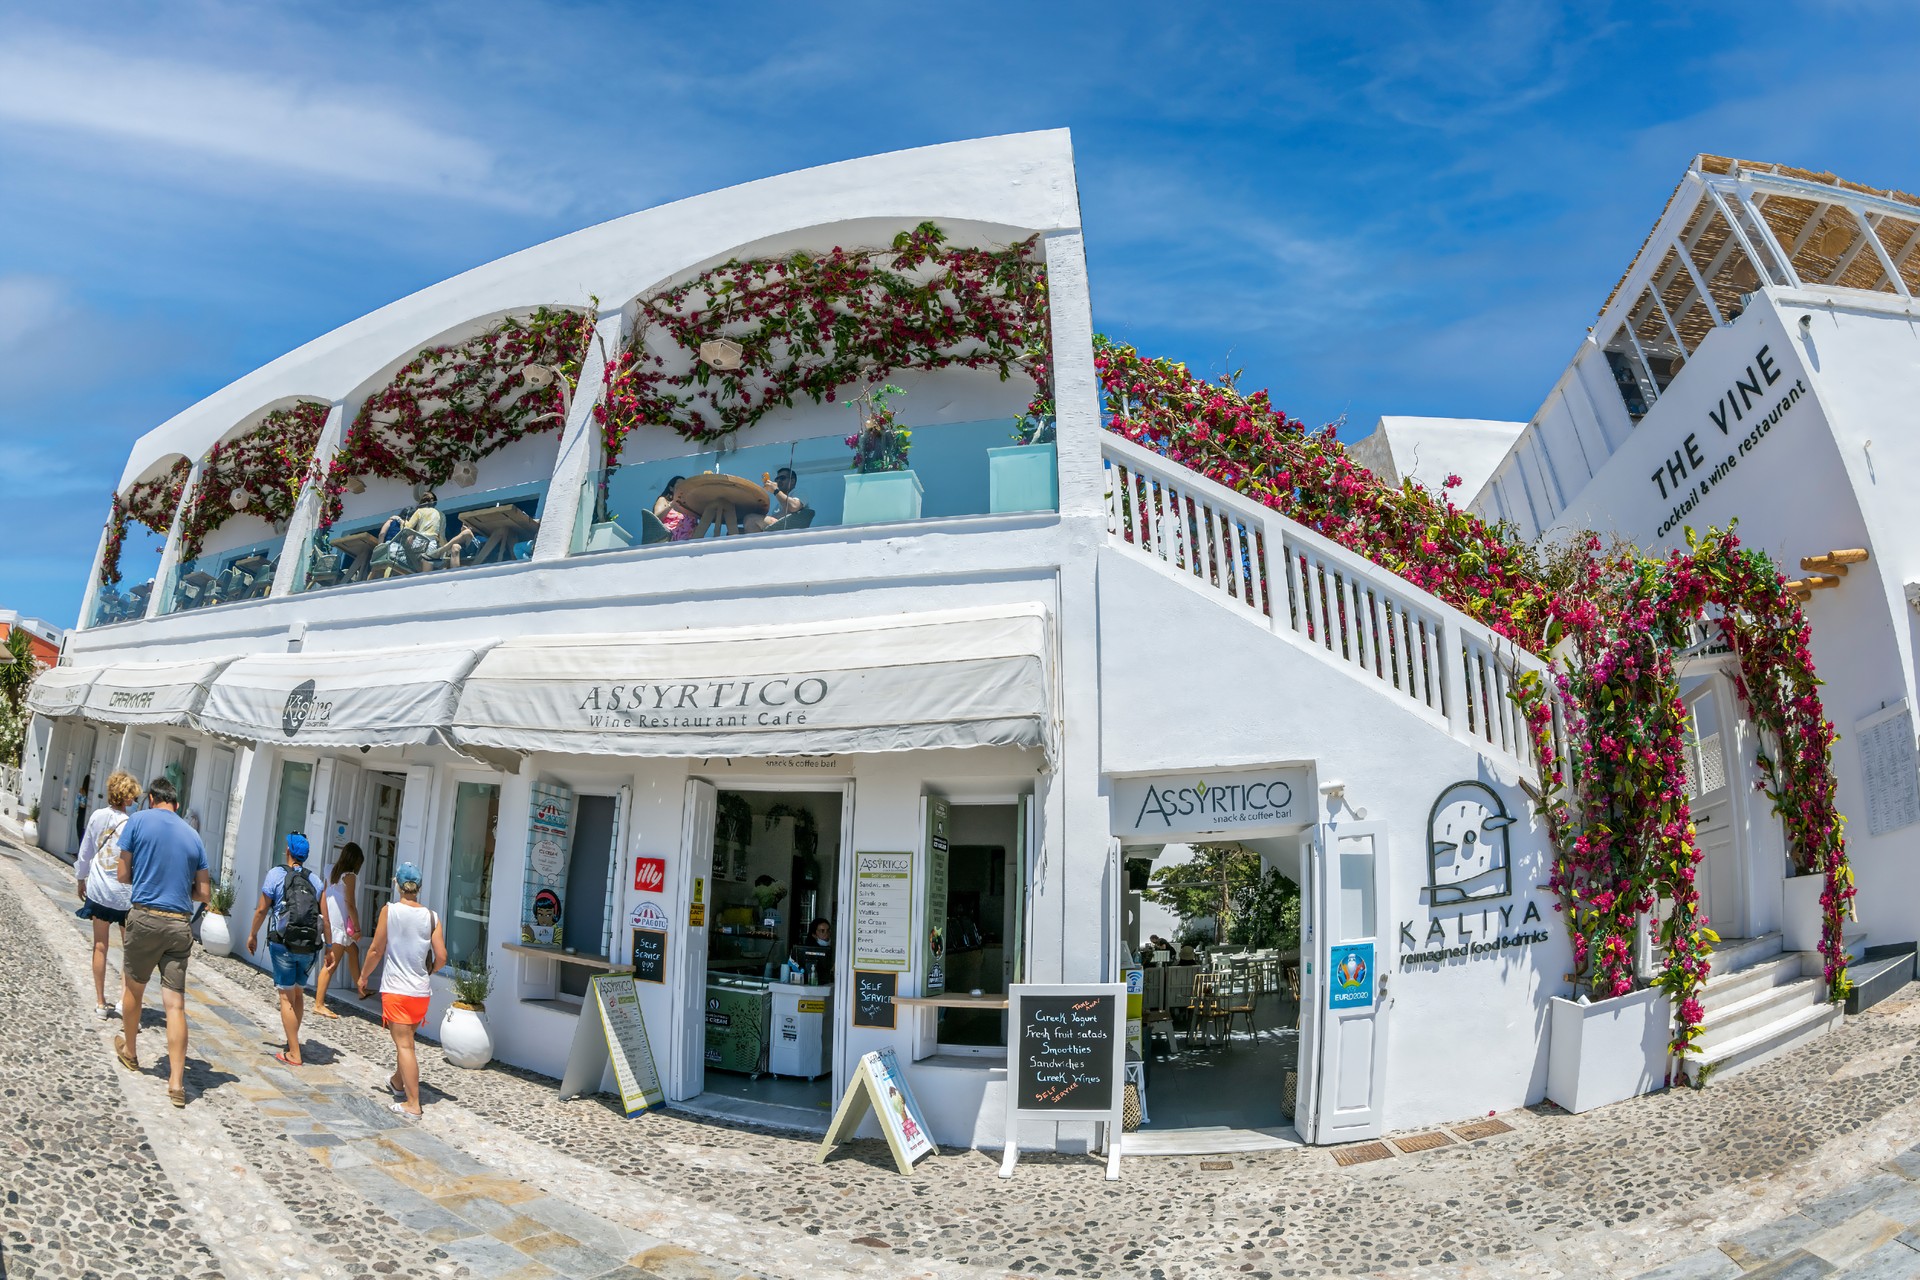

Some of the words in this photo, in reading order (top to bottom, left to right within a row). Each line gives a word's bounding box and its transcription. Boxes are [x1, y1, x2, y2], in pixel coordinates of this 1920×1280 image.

[1651, 432, 1704, 499] THE
[1709, 344, 1781, 435] VINE
[1657, 488, 1699, 538] cocktail
[1700, 481, 1709, 495] &
[1708, 455, 1737, 486] wine
[1738, 379, 1806, 457] restaurant
[579, 678, 828, 713] ASSYRTICO
[590, 715, 631, 728] Wine
[639, 714, 747, 728] Restaurant
[758, 710, 807, 726] Café
[765, 759, 787, 768] snack
[1134, 780, 1292, 828] ASSYRTICO
[1213, 813, 1238, 824] snack
[1239, 813, 1247, 821] &
[1247, 811, 1274, 821] coffee
[859, 858, 908, 871] ASSYRTICO
[637, 863, 663, 889] illy
[1400, 901, 1541, 944] KALIYA
[640, 938, 658, 949] SELF
[1401, 943, 1469, 965] reimagined
[1471, 938, 1501, 954] food
[1511, 930, 1548, 946] drinks
[634, 949, 661, 960] SERVICE
[860, 979, 883, 990] SELF
[1035, 1009, 1067, 1024] Greek
[1071, 1012, 1097, 1026] Yogurt
[1025, 1024, 1050, 1040] Fresh
[1054, 1026, 1073, 1038] fruit
[1077, 1029, 1107, 1039] salads
[1041, 1041, 1091, 1055] Smoothies
[1030, 1056, 1085, 1070] Sandwiches
[1037, 1071, 1067, 1083] Greek
[1072, 1073, 1100, 1084] Wines
[1035, 1085, 1056, 1101] SELF
[1051, 1082, 1078, 1103] SERVICE
